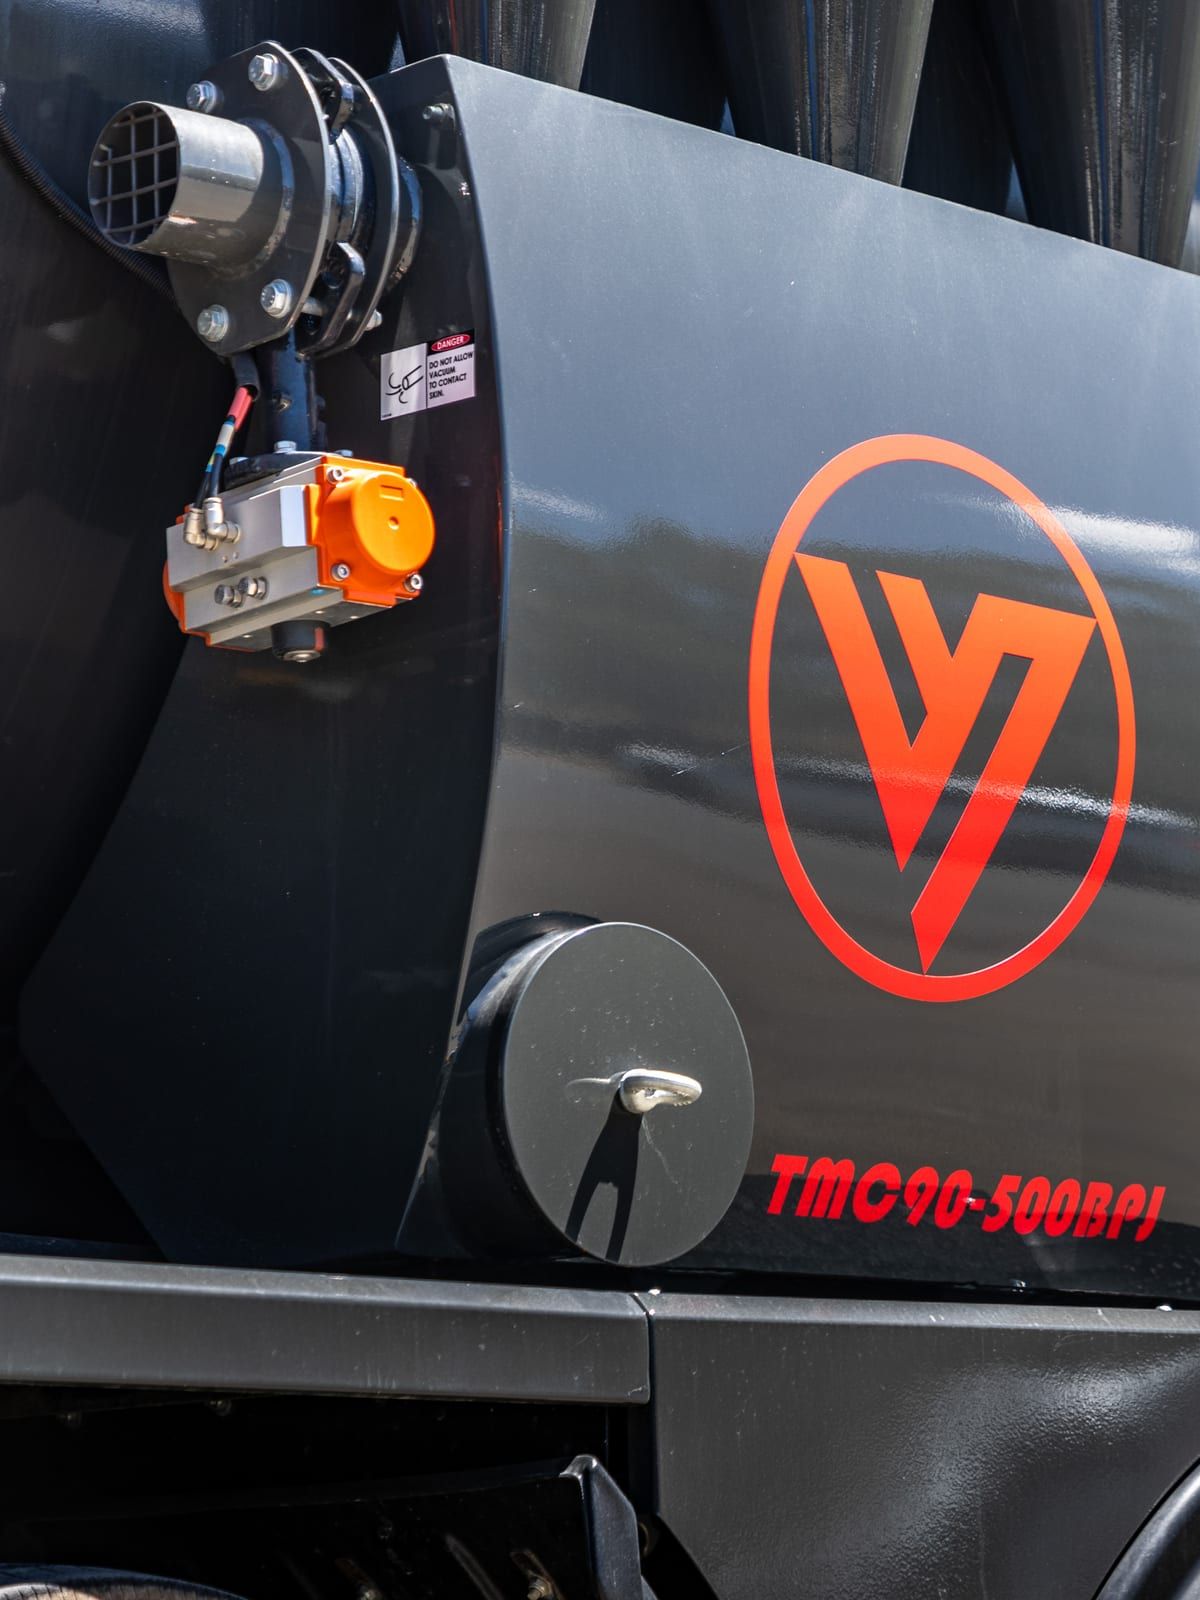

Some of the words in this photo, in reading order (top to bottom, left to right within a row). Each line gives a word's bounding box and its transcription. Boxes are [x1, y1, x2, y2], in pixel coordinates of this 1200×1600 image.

[437, 336, 464, 350] DANGER
[429, 361, 438, 369] DO
[440, 357, 452, 366] NOT
[454, 352, 473, 362] ALLOW
[429, 367, 455, 378] VACUUM
[429, 381, 437, 389] TO
[438, 373, 467, 387] CONTACT
[429, 390, 444, 399] SKIN.
[767, 1153, 1167, 1242] TMC90-500BPJ
